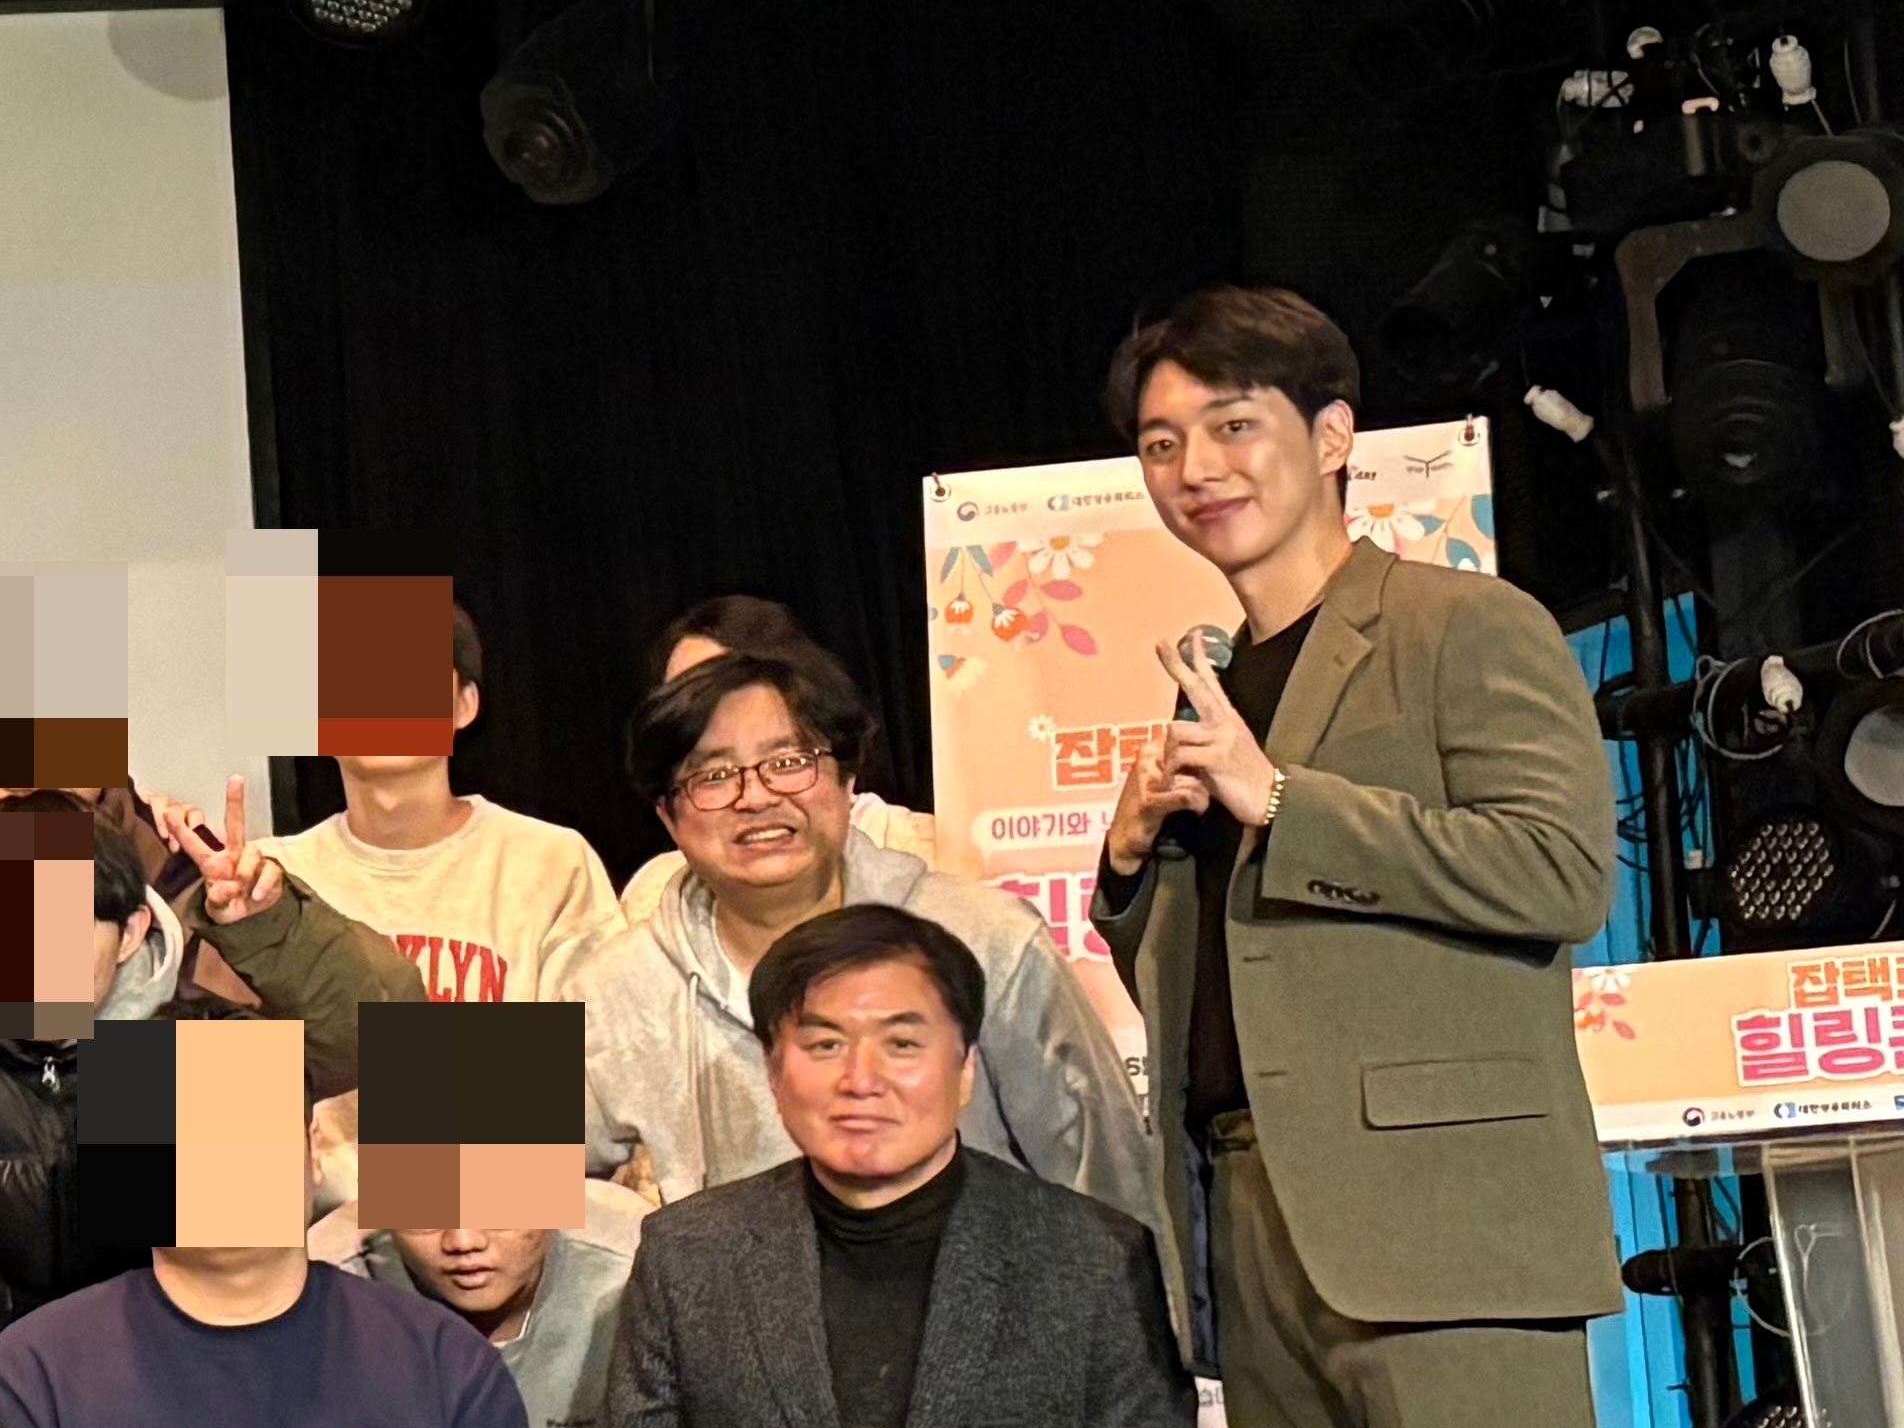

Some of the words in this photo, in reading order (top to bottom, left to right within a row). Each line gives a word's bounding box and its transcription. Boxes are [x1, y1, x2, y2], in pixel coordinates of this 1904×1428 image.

[992, 812, 1091, 840] 이야기와
[1791, 956, 1904, 1009] 잡택
[1735, 1005, 1904, 1082] 힐링
